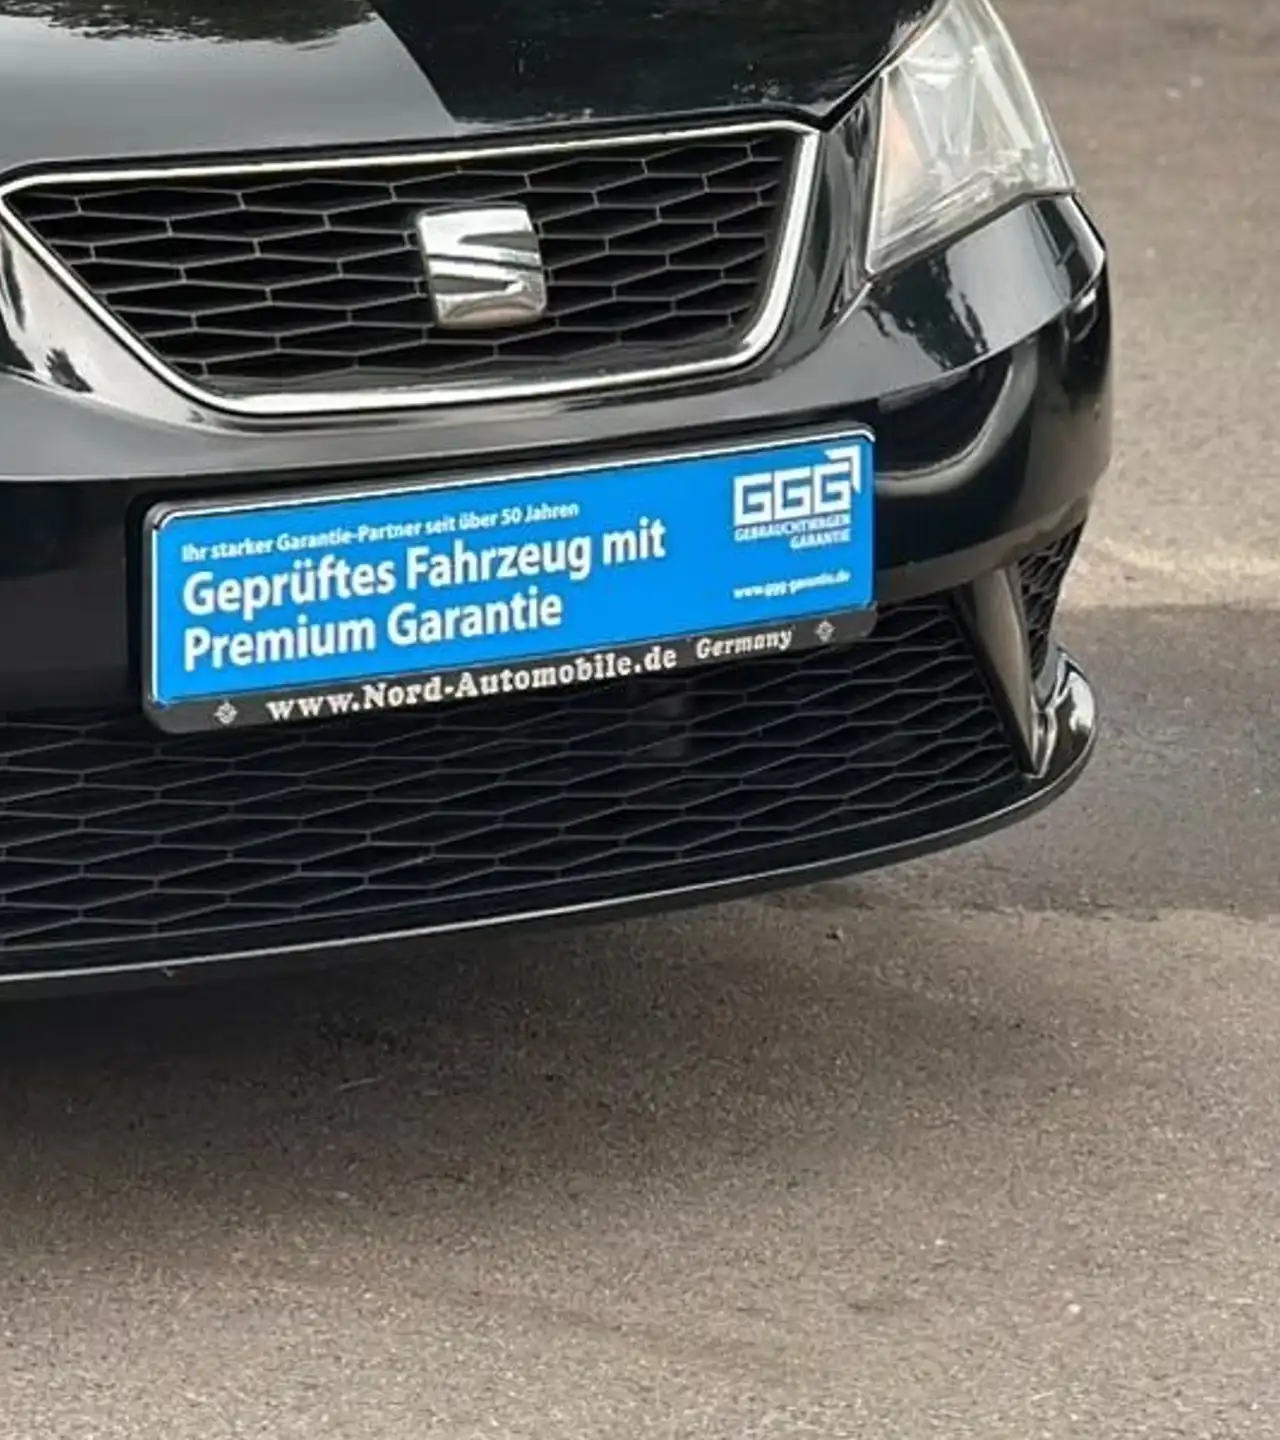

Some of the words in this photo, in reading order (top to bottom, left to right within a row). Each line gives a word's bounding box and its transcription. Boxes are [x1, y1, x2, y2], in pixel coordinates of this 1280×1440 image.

[180, 542, 209, 562] Ihr
[211, 537, 272, 559] starker
[276, 521, 421, 552] Garantie-Partner
[424, 514, 456, 535] seit
[458, 511, 497, 530] über
[501, 507, 522, 525] 50
[524, 500, 580, 522] Jahren
[733, 460, 853, 527] GGG
[182, 554, 397, 622] Geprüftes
[406, 533, 593, 590] Fahrzeug
[601, 515, 667, 566] mit
[183, 613, 377, 673] Premium
[386, 584, 564, 647] Garantie
[265, 646, 679, 722] www.Nord-Automobile.de
[694, 625, 794, 661] Germany
